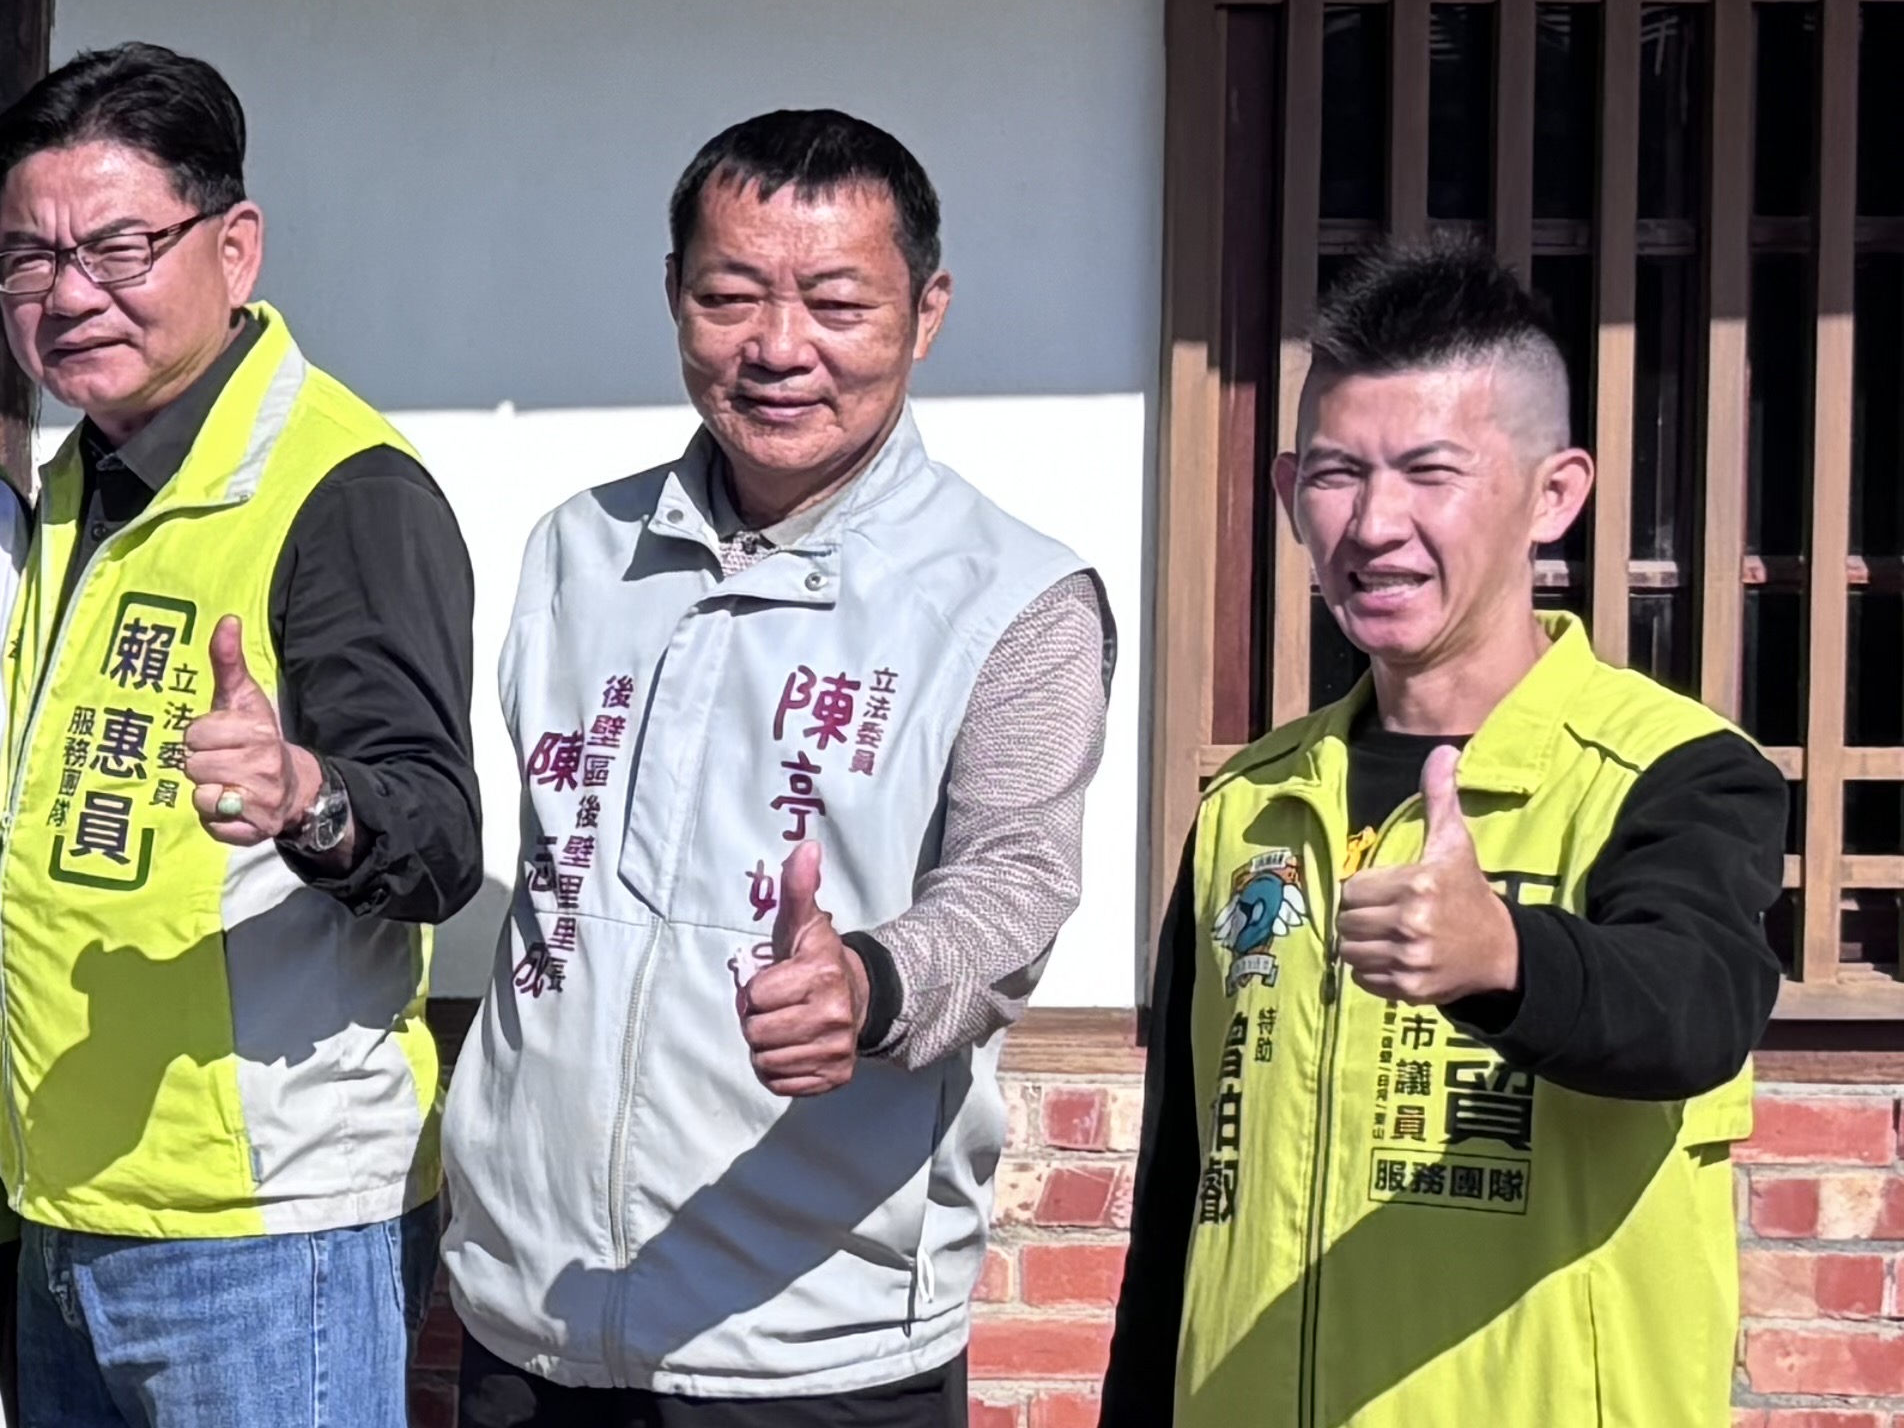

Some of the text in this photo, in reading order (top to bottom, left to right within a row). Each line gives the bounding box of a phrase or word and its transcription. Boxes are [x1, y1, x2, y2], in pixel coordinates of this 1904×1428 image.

[46, 704, 97, 828] 服務團隊
[69, 616, 177, 866] 賴惠員
[148, 663, 200, 810] 立法委員
[848, 666, 899, 777] 立法委員
[1253, 1006, 1279, 1063] 特助
[1373, 1158, 1525, 1203] 服務團隊
